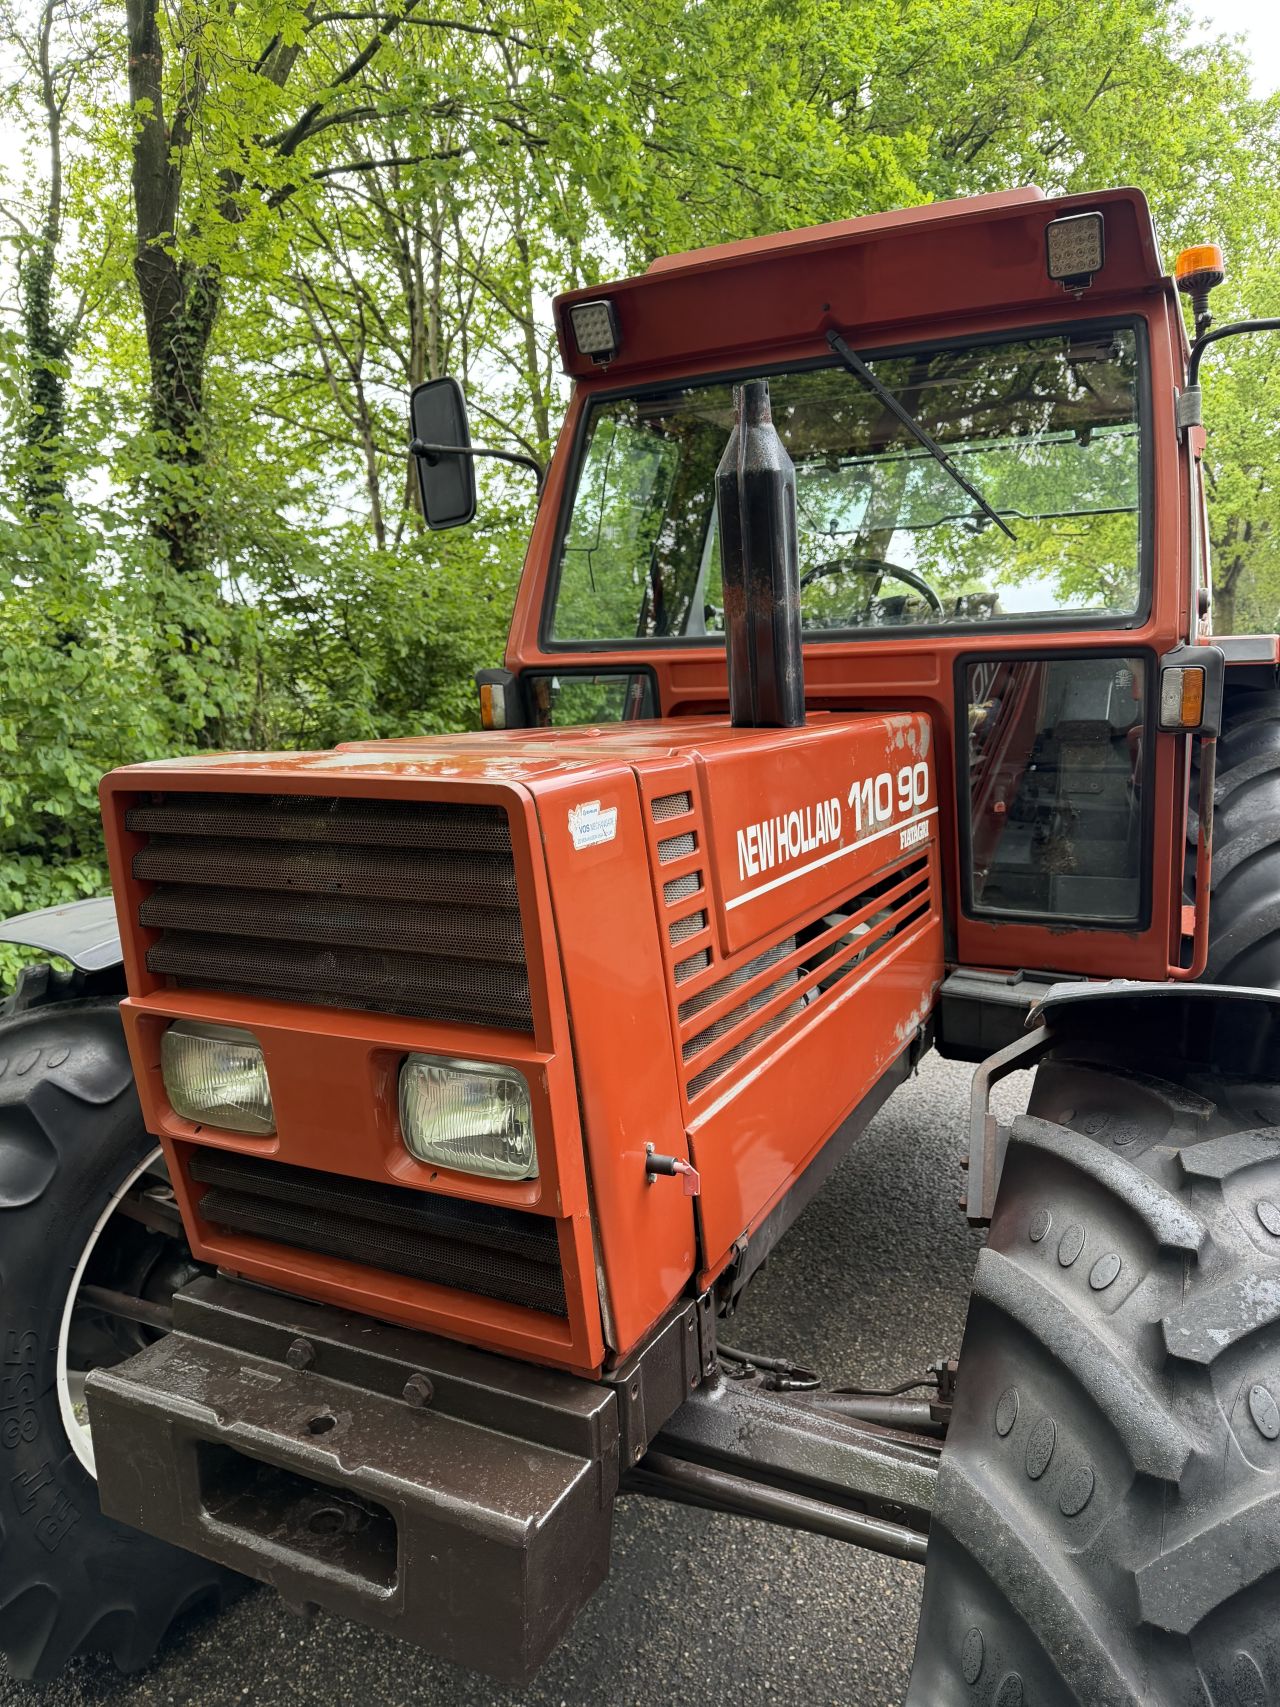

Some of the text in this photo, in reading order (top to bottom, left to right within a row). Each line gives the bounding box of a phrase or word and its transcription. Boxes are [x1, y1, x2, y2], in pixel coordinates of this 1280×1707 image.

[737, 761, 929, 881] NEW HOLLAND 110 90
[0, 1330, 81, 1551] RT 855
